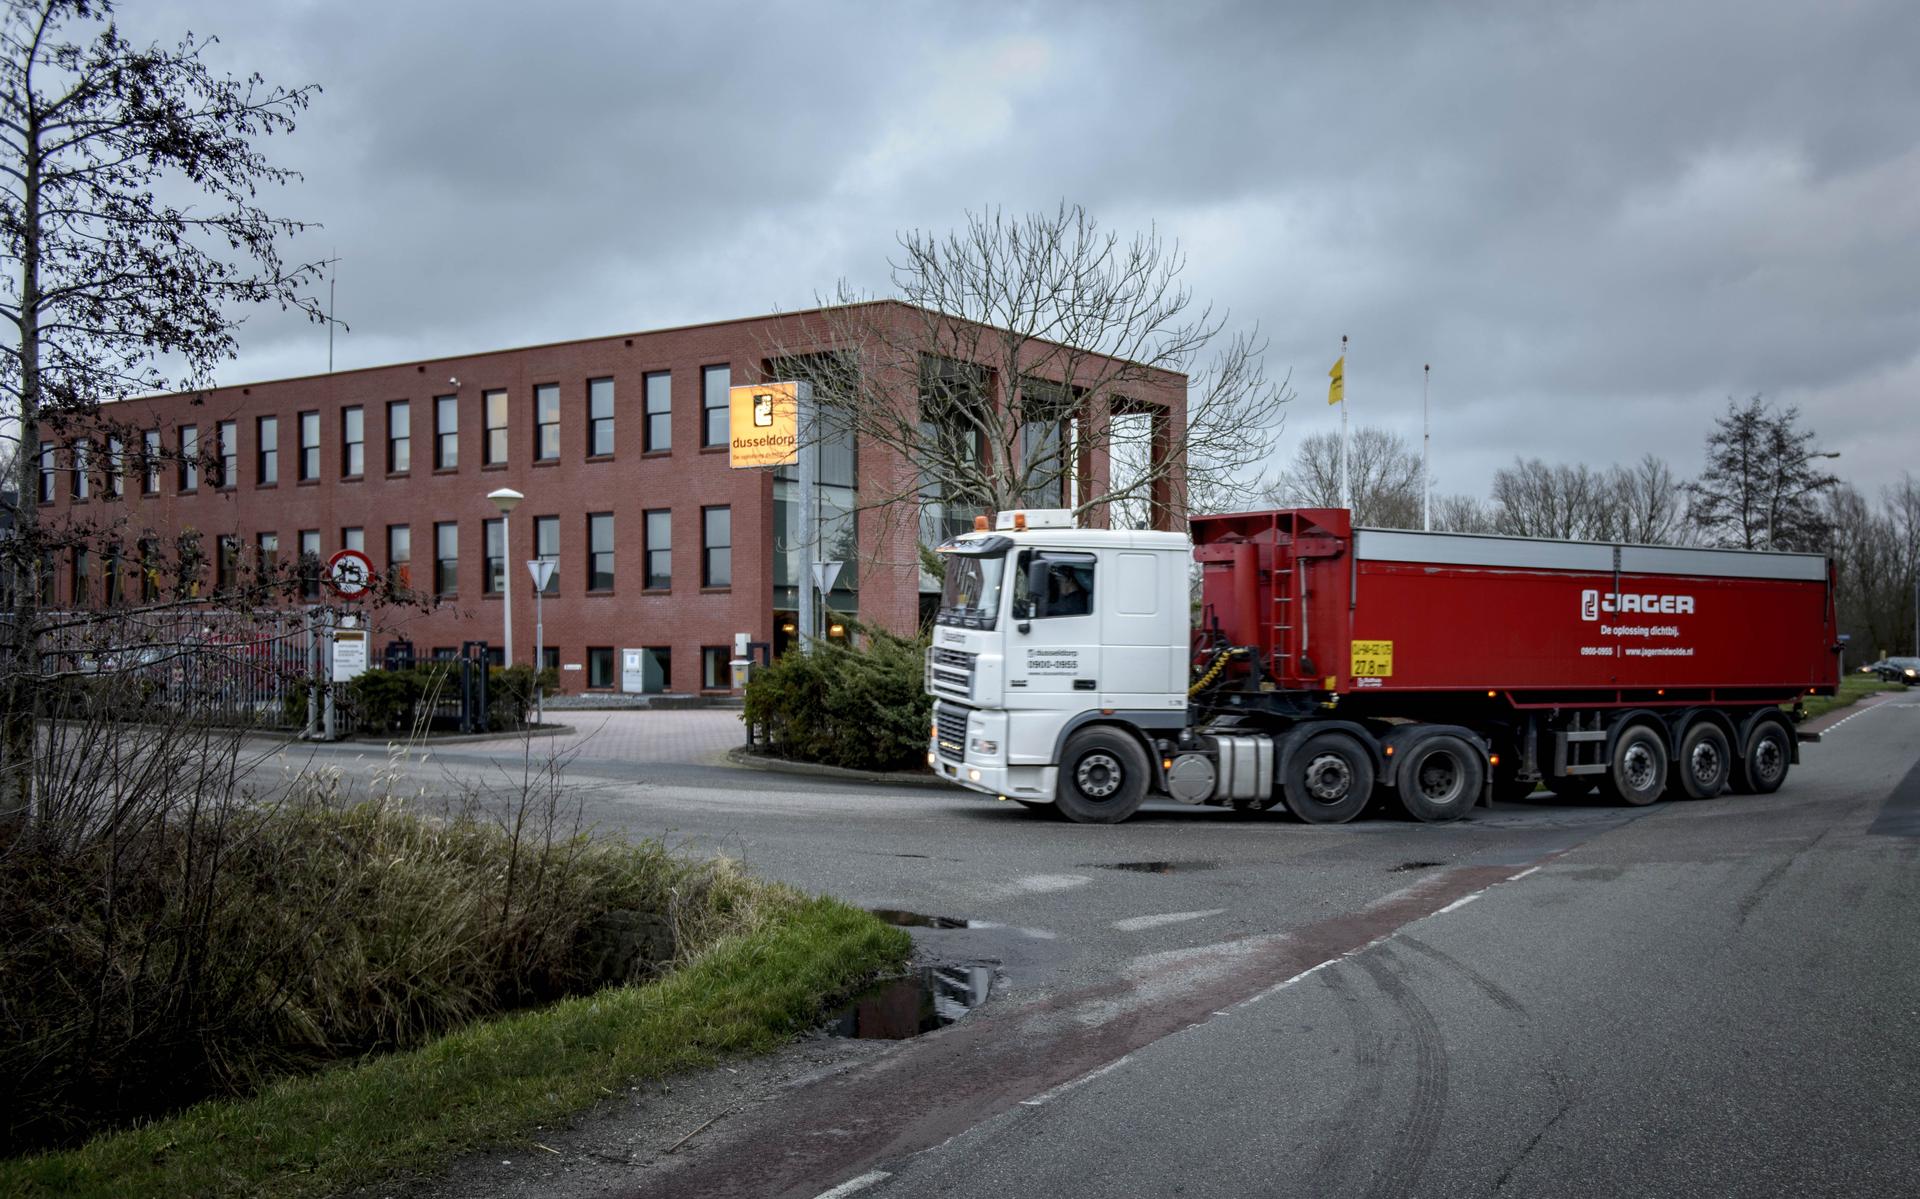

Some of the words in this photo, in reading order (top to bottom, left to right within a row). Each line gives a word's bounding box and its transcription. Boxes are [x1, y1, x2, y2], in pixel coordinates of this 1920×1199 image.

[732, 434, 795, 448] dusseldorp
[1602, 593, 1694, 614] JAGER
[1600, 625, 1612, 635] De
[1613, 625, 1649, 637] oplossing
[1650, 625, 1679, 637] dichtbij.
